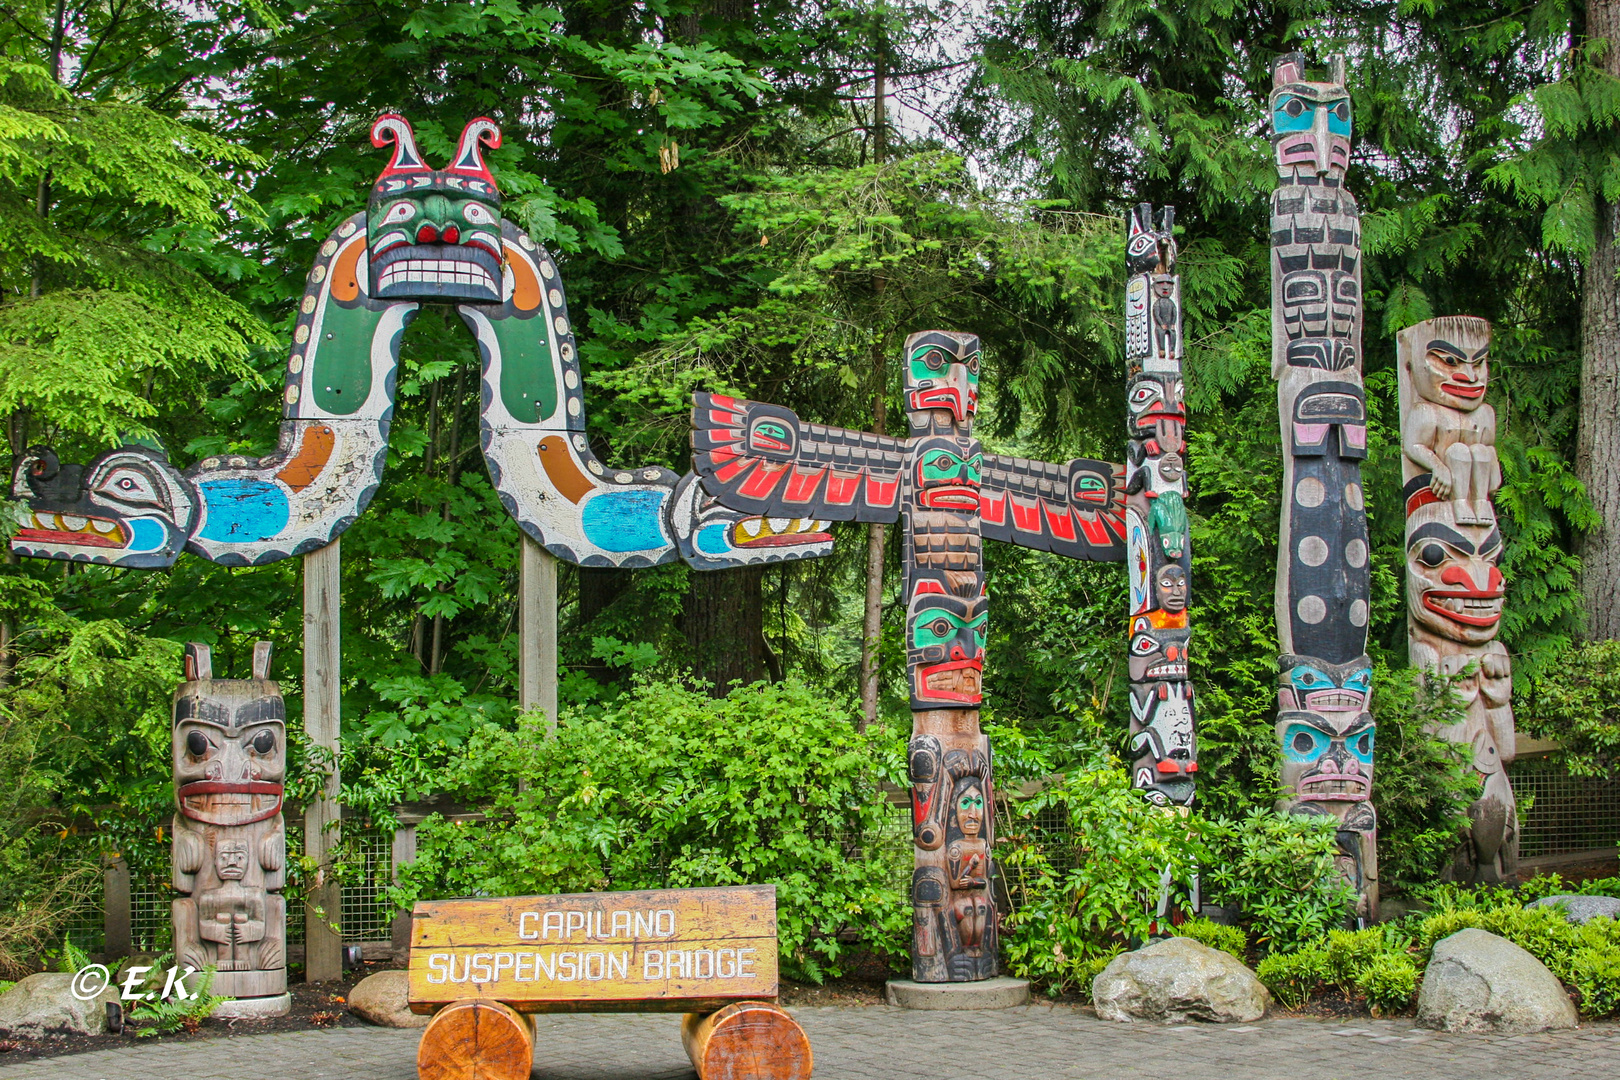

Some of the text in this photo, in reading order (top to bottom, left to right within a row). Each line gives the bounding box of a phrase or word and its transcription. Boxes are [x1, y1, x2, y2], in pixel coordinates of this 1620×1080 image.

[518, 909, 675, 940] CAPILANO
[426, 947, 757, 984] SUSPENSION BRIDGE
